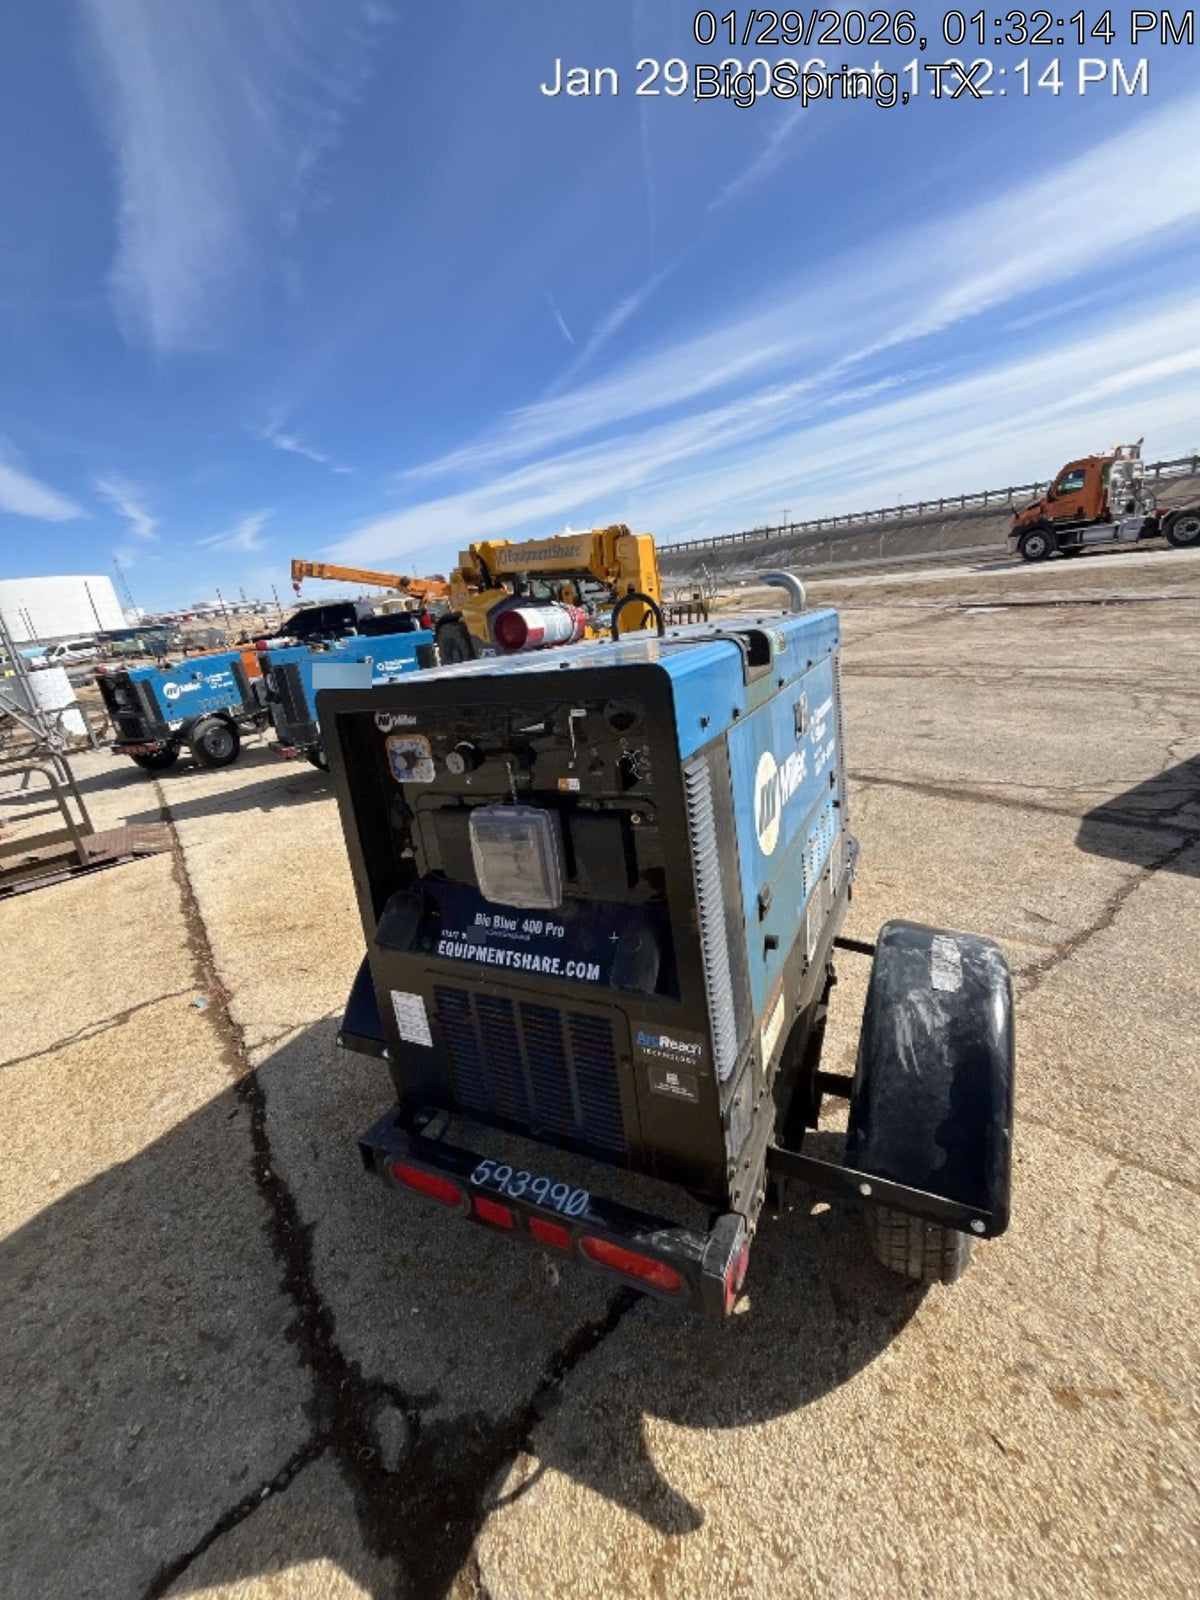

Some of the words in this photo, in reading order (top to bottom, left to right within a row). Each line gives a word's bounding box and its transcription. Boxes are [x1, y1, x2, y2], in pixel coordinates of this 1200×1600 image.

[474, 912, 492, 927] Big
[522, 918, 543, 934] 400
[545, 922, 565, 938] Pro
[437, 940, 600, 981] EQUIPMENTSHARE.COM
[470, 1159, 590, 1216] 593990
